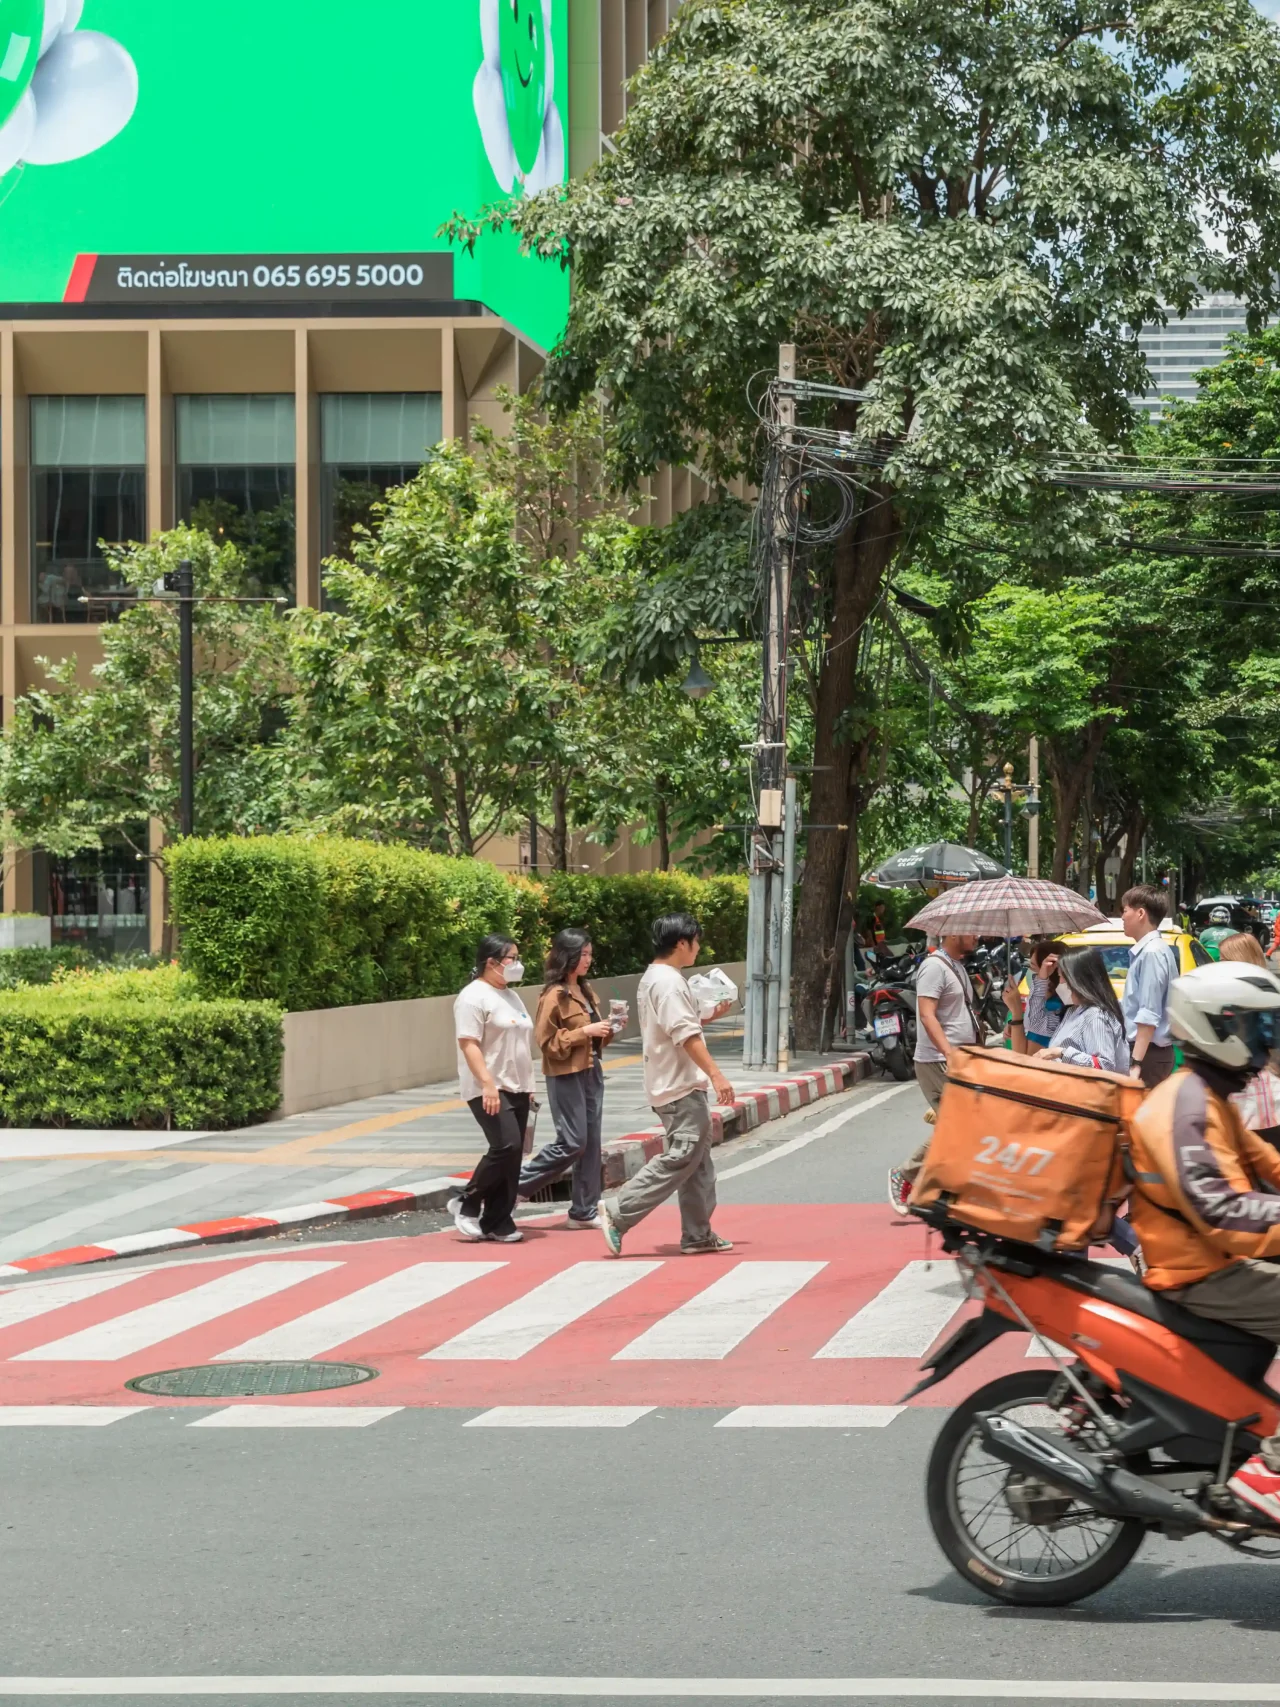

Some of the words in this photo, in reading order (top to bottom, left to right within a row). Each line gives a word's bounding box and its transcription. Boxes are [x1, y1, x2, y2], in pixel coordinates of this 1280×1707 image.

[117, 261, 249, 289] ติดต่อโฆษณา
[252, 265, 301, 287] 065
[304, 264, 352, 287] 695
[355, 264, 424, 286] 5000
[974, 1135, 1056, 1177] 24/7
